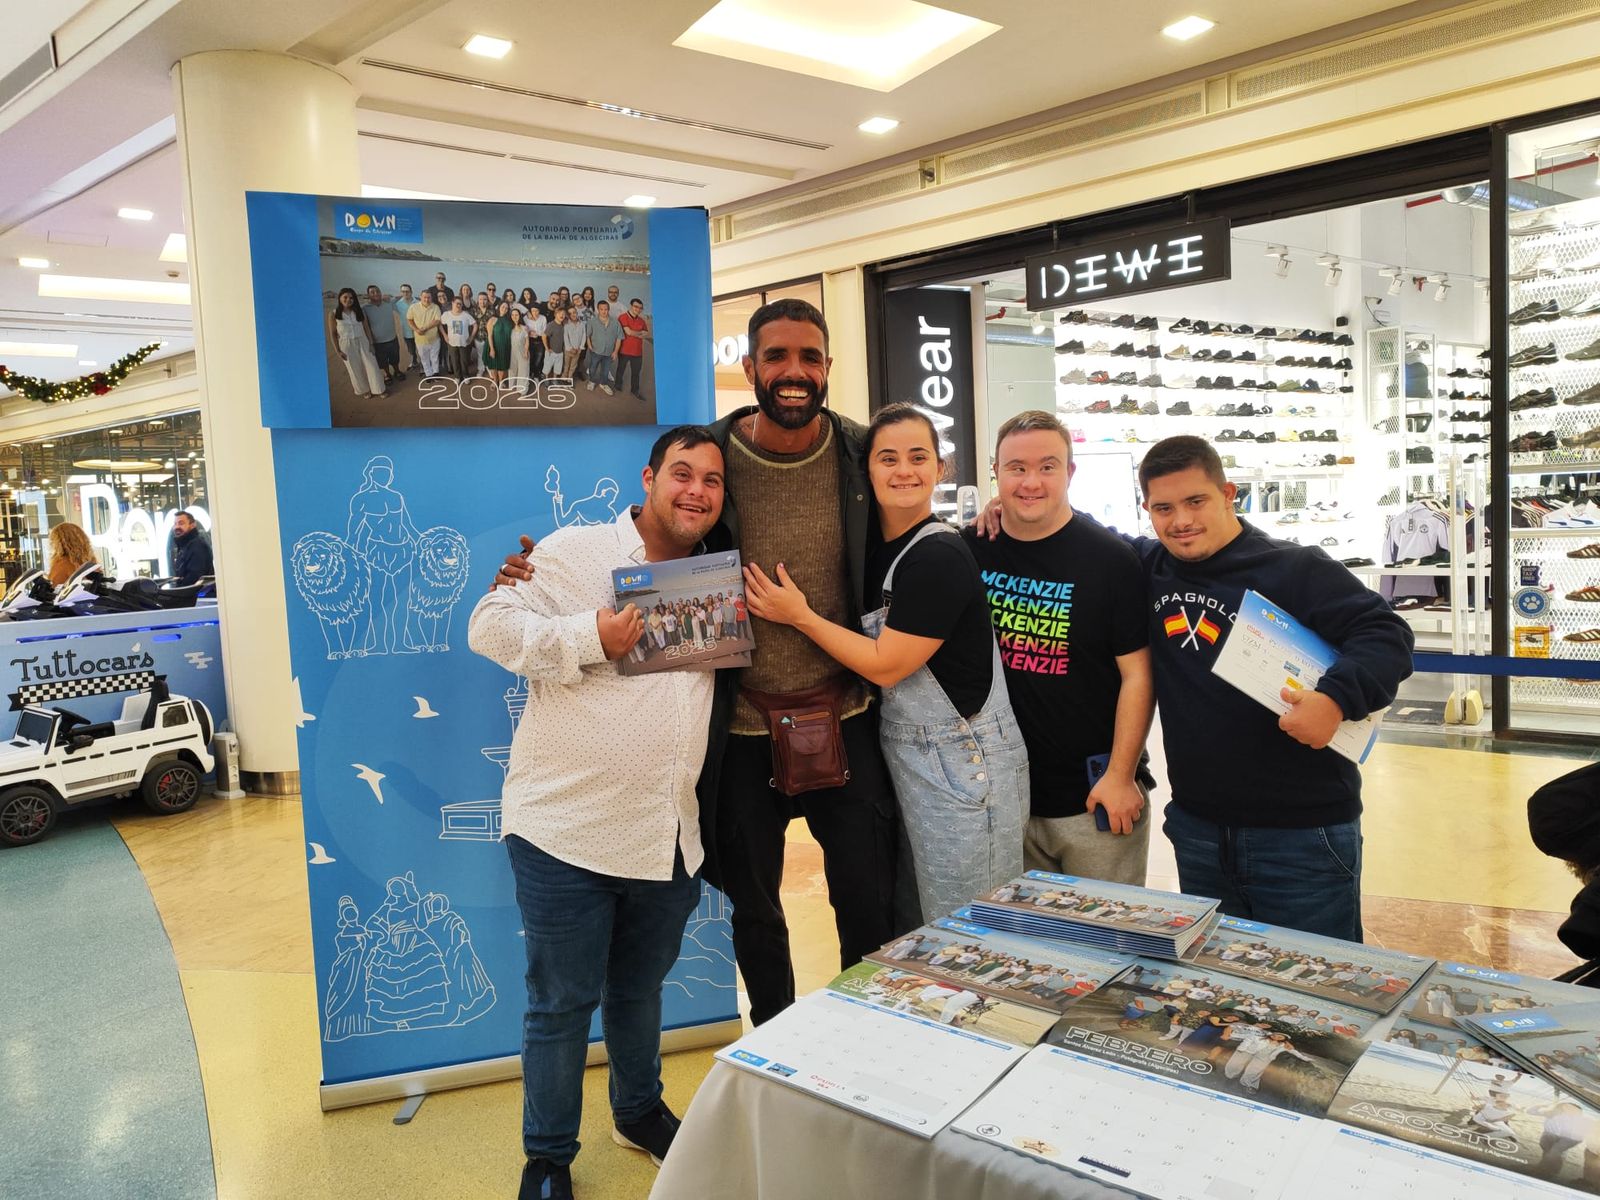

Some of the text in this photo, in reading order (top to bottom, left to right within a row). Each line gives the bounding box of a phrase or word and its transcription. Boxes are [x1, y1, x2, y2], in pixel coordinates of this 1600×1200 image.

[345, 212, 396, 230] DOWN
[522, 225, 618, 234] AUTORIDAD PORTUARIA
[418, 376, 577, 410] 2026
[10, 649, 155, 682] Tuttocars
[1492, 1017, 1535, 1028] DOWN
[1066, 1026, 1213, 1075] FEBRERO
[1351, 1102, 1519, 1154] AGOSTO
